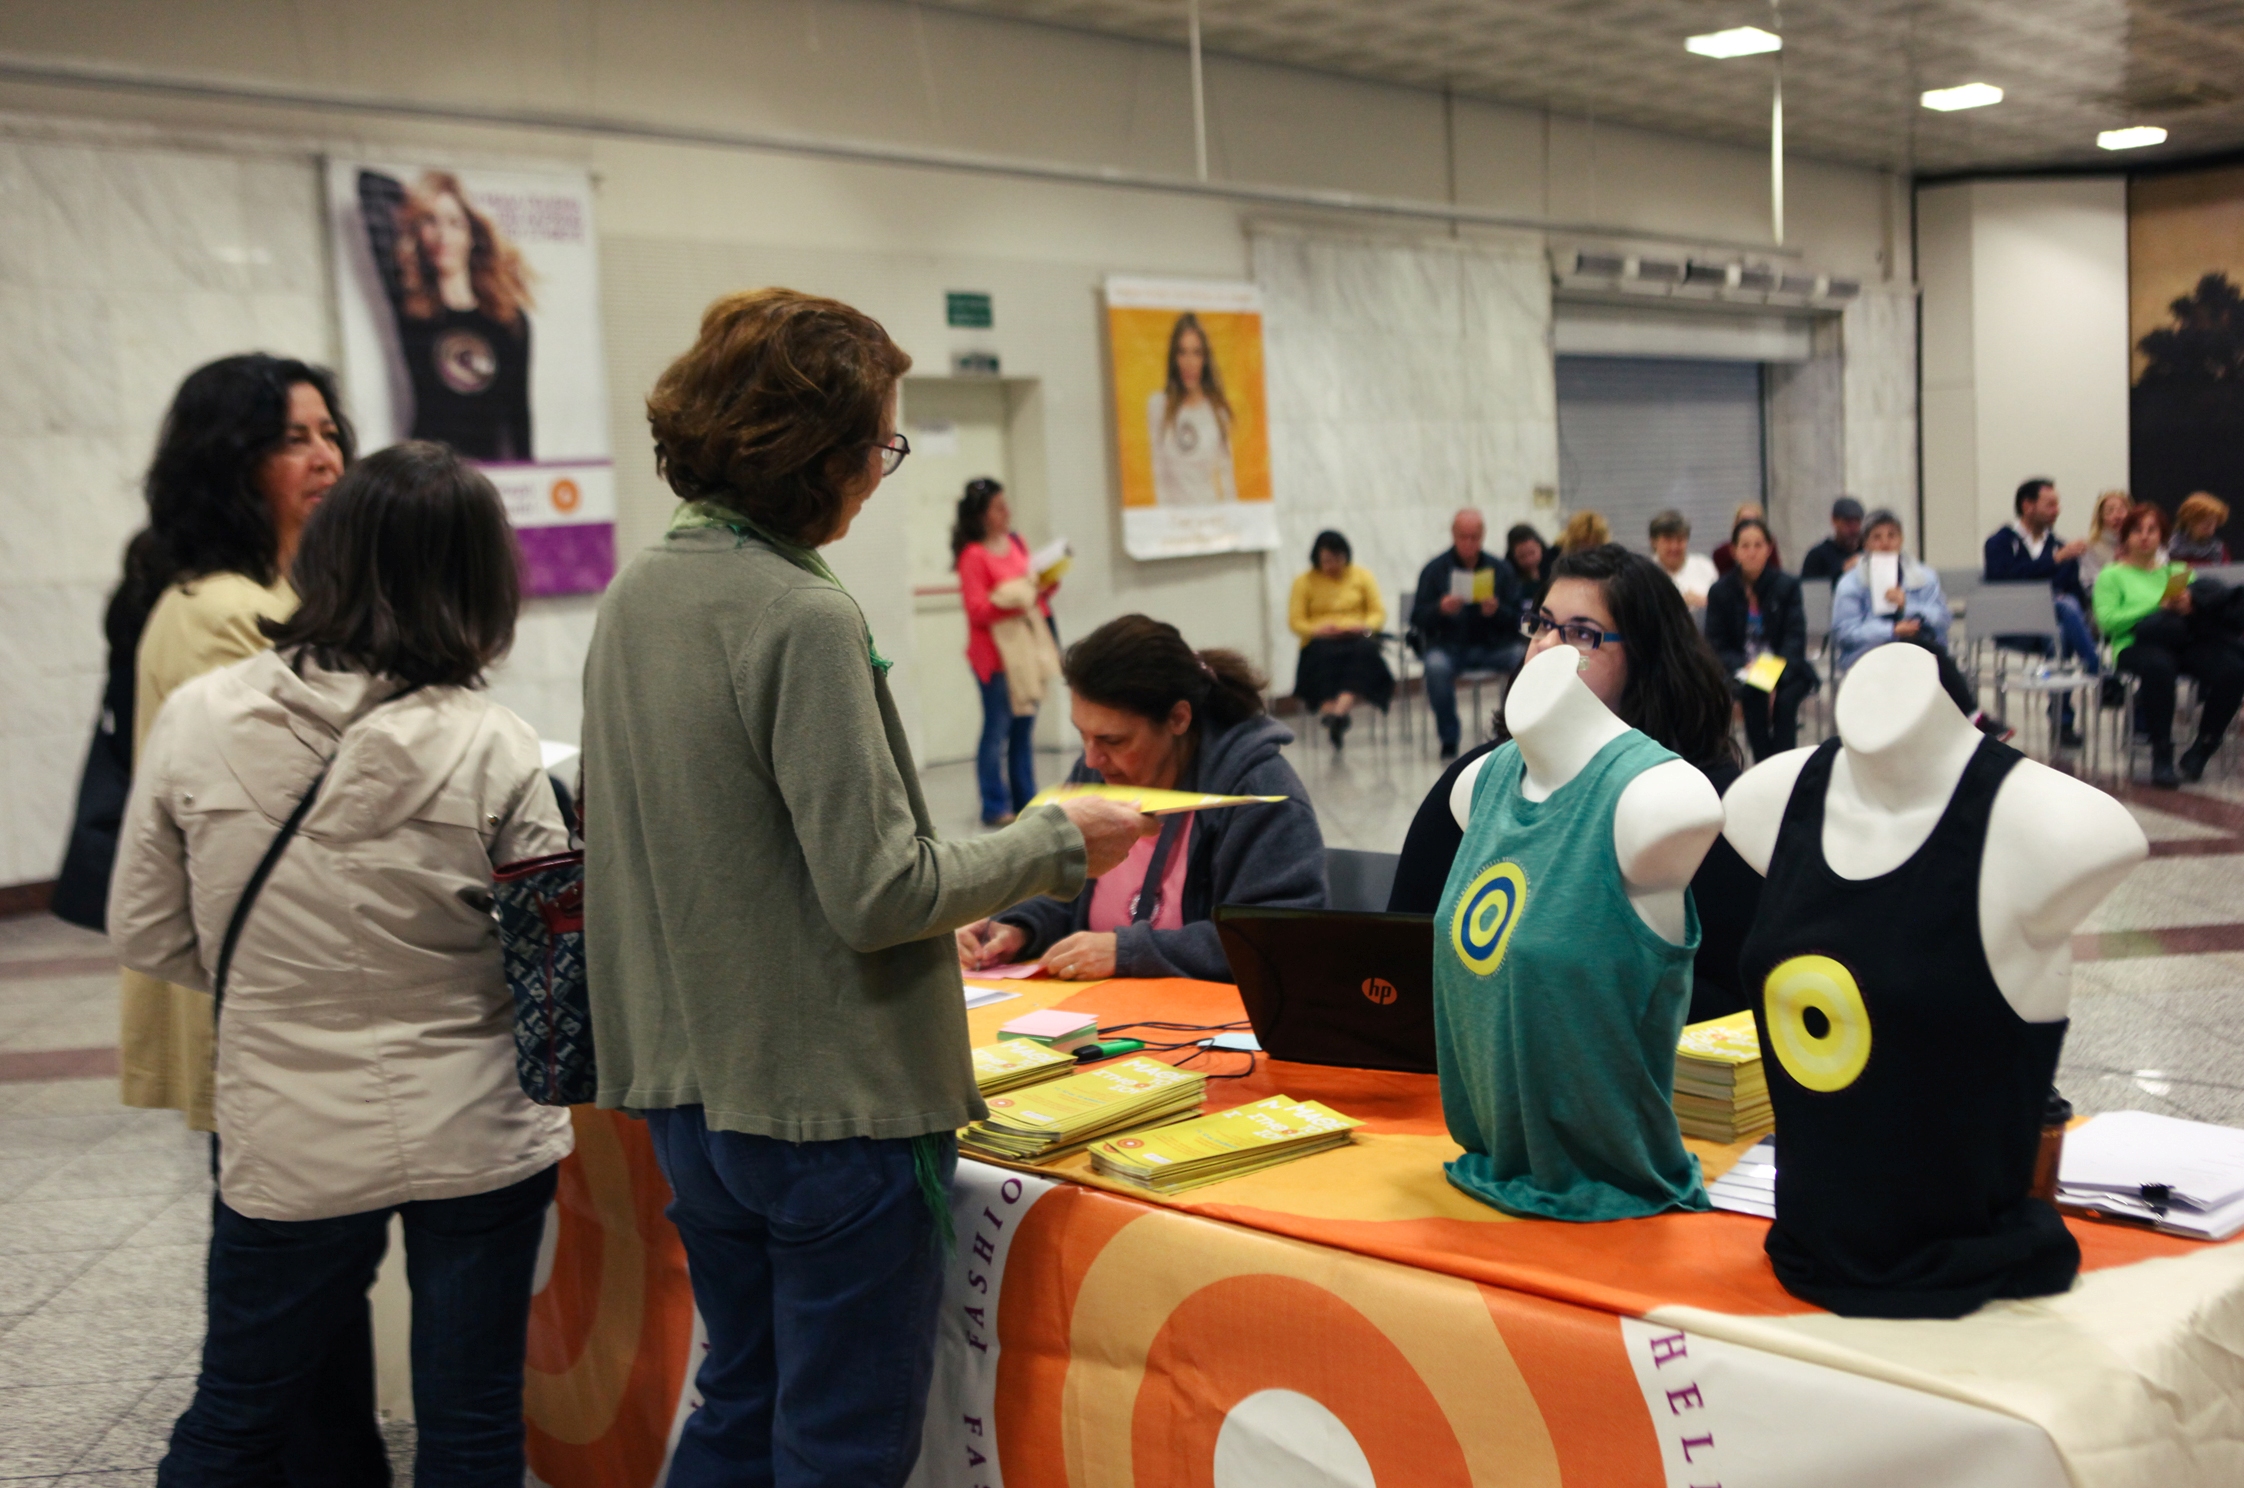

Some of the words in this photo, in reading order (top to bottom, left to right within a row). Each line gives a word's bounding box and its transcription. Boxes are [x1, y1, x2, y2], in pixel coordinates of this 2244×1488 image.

[1367, 977, 1393, 1005] hp
[964, 1175, 1046, 1354] FASHIO
[963, 1413, 991, 1488] FA
